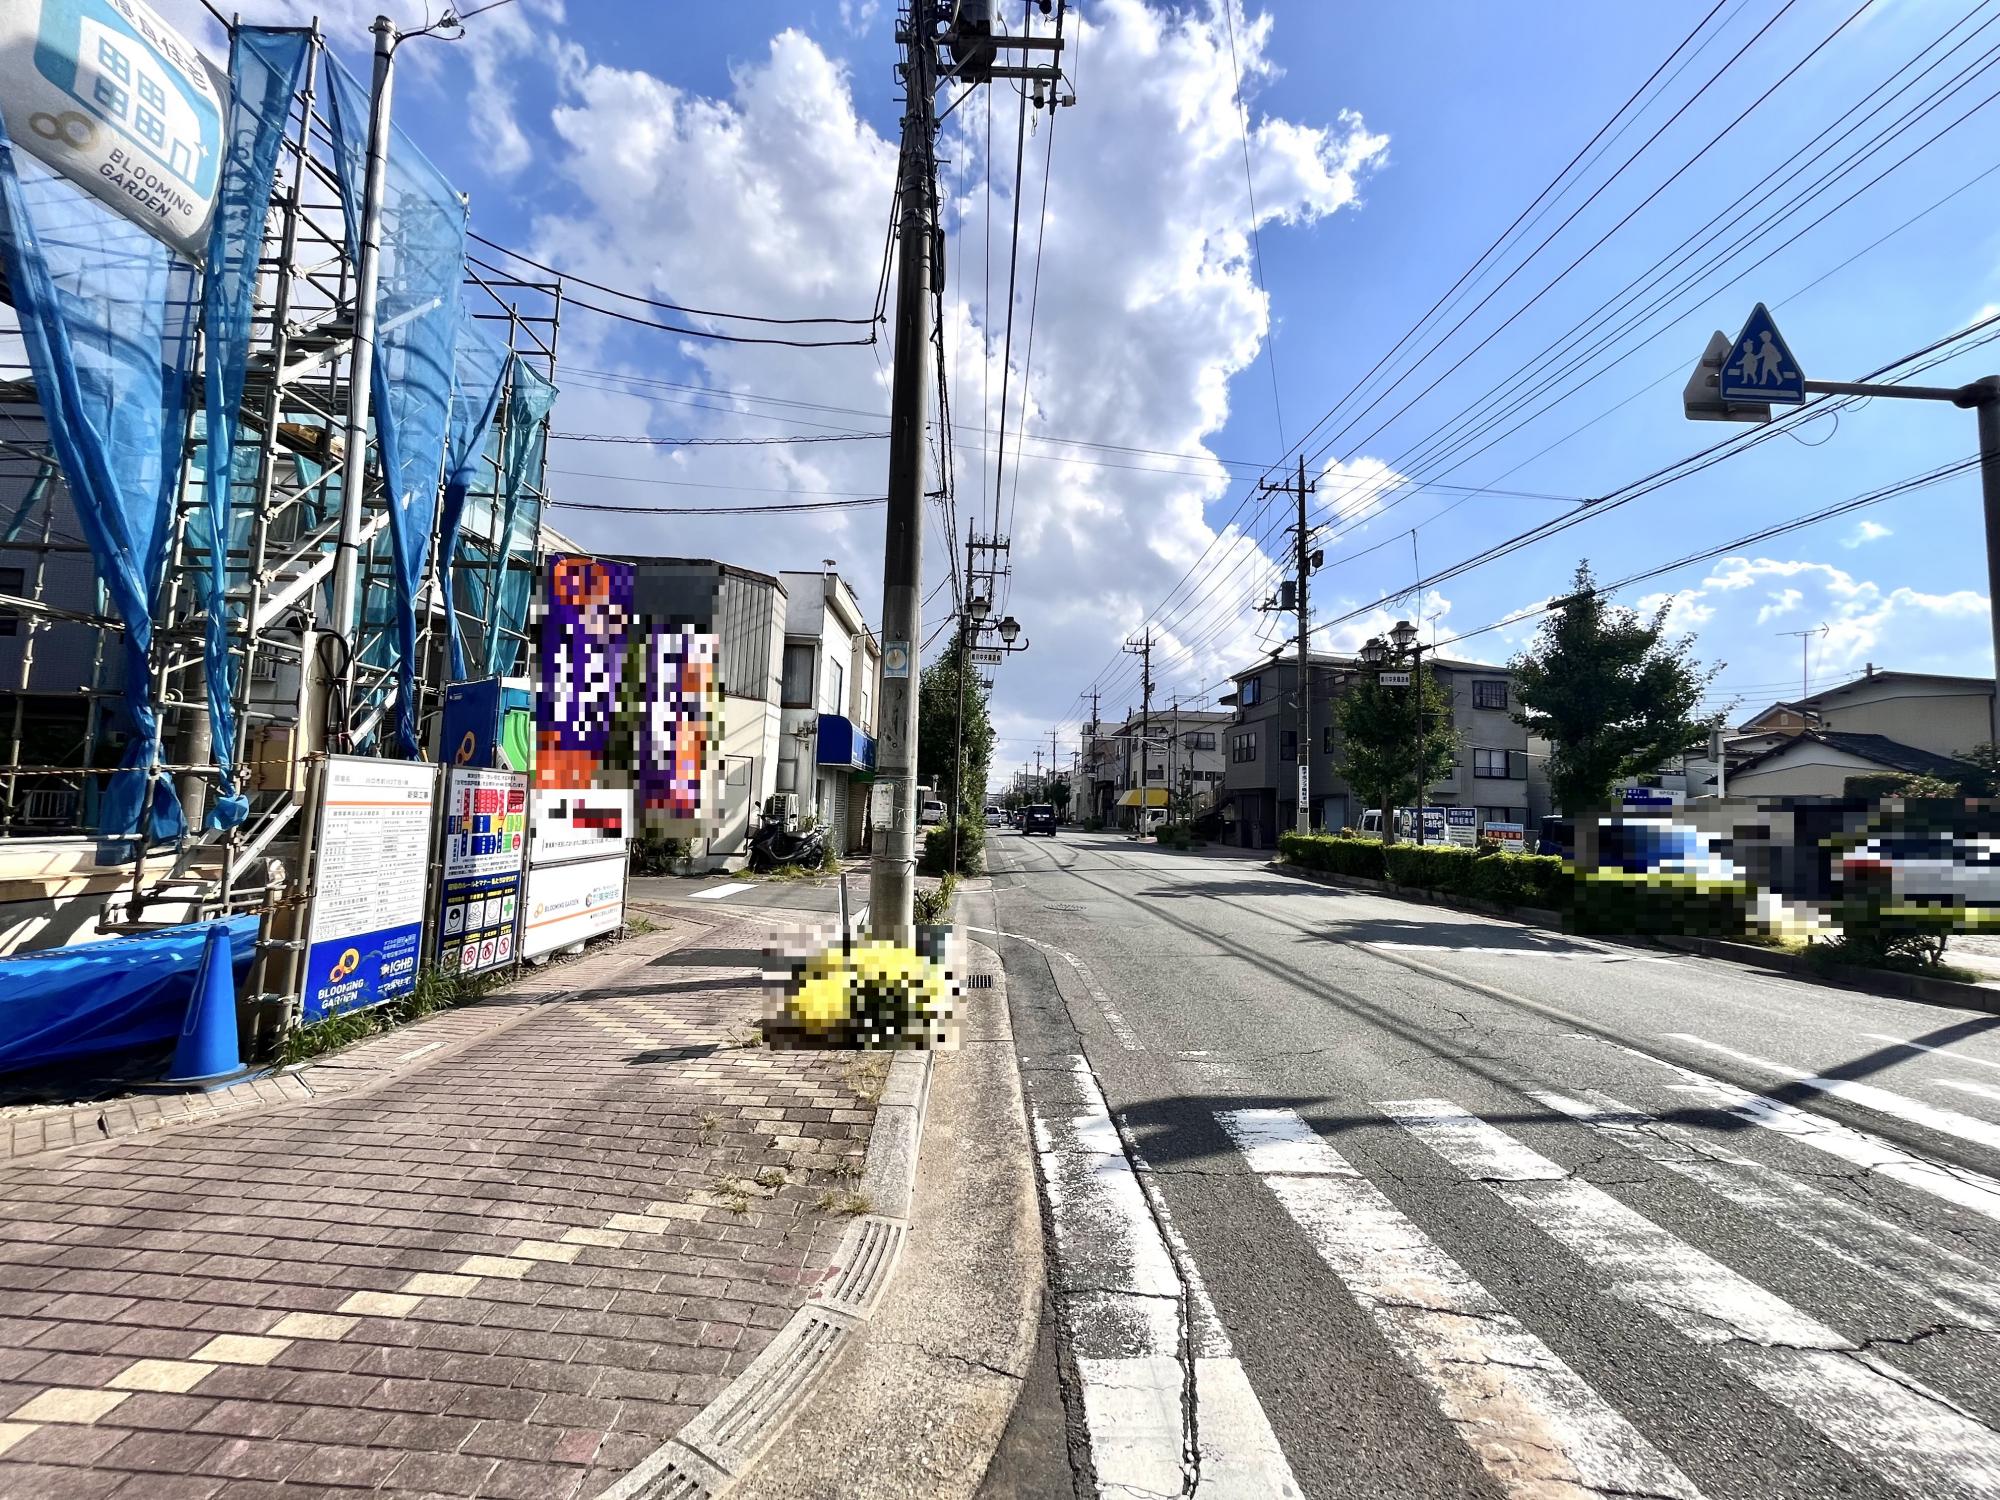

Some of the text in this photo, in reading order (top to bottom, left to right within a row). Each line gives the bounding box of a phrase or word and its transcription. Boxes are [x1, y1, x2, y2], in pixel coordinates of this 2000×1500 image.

[99, 163, 172, 218] GARDEN
[109, 148, 193, 216] BLOOMING
[318, 980, 364, 999] BLOOMING
[322, 991, 357, 1009] GARDEN
